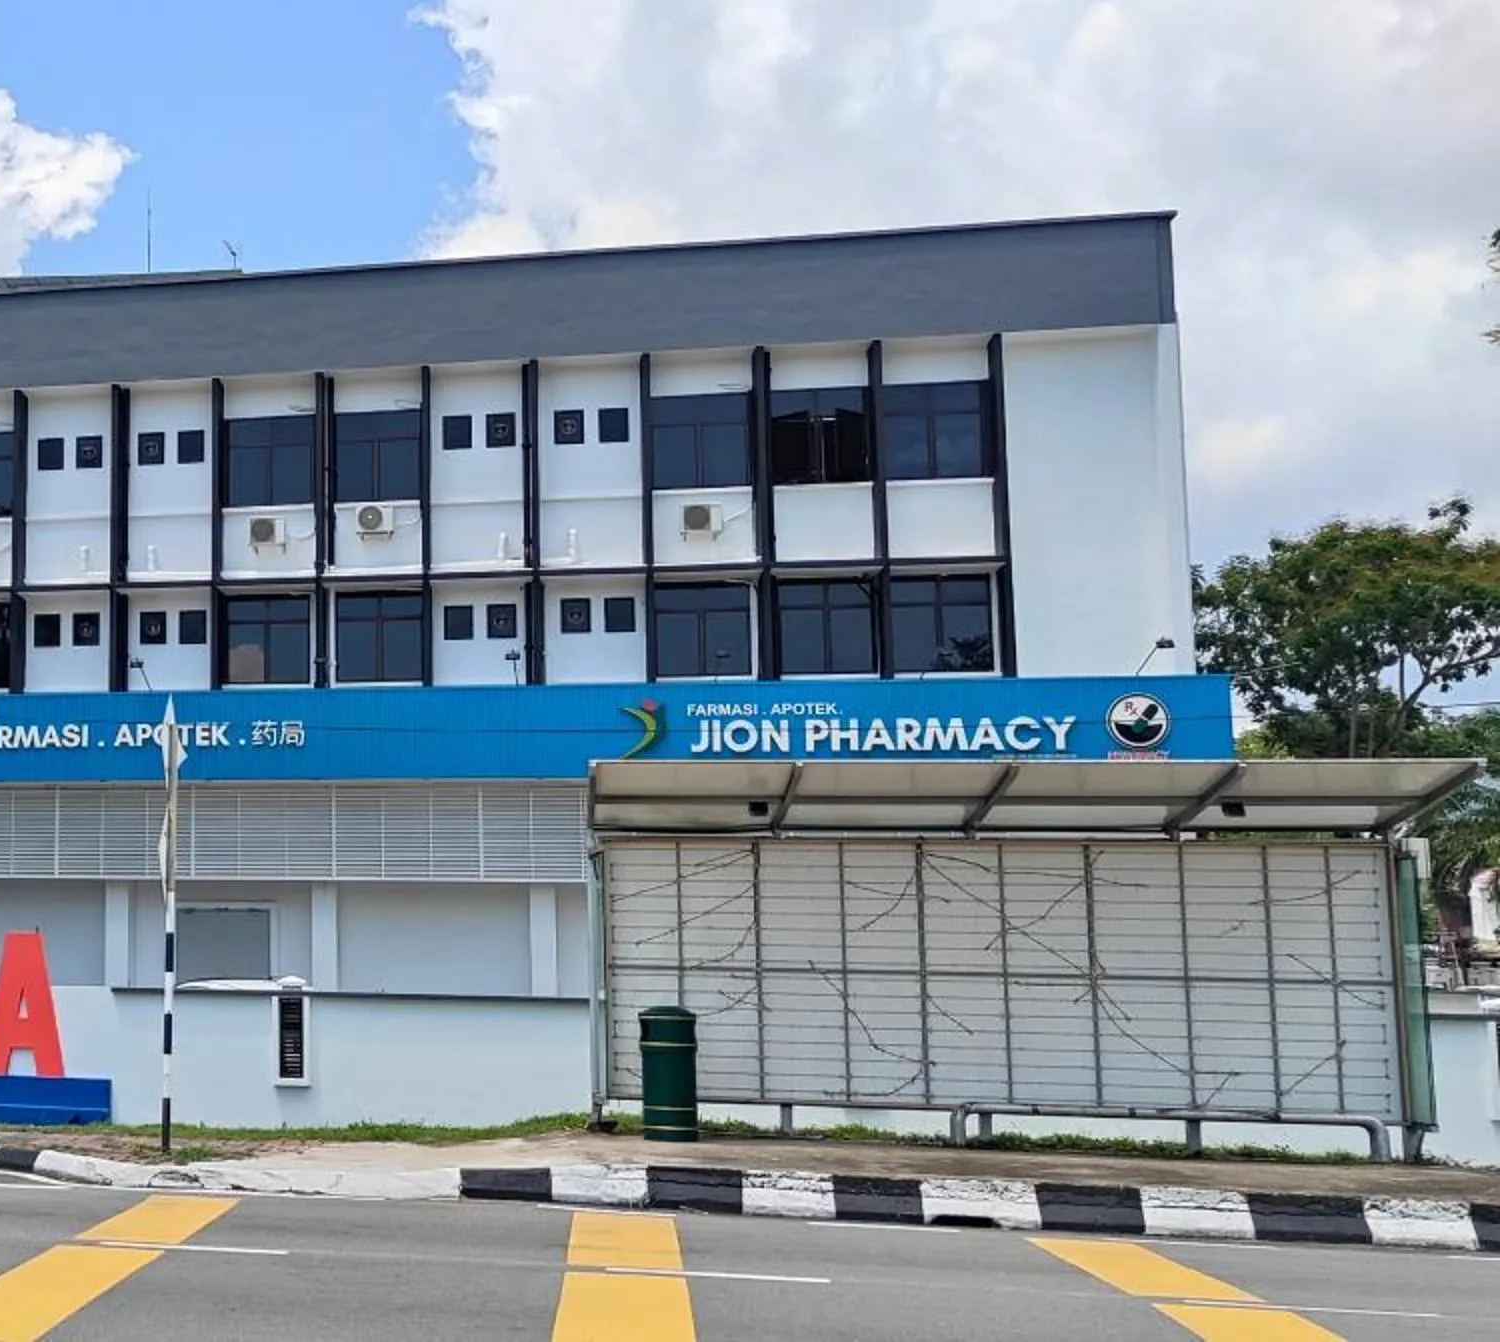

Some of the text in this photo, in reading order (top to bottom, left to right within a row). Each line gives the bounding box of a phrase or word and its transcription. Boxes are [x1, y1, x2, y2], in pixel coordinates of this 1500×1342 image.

[687, 703, 758, 716] FARMASI
[252, 720, 305, 747] 药局
[690, 716, 1076, 753] JION PHARMACY
